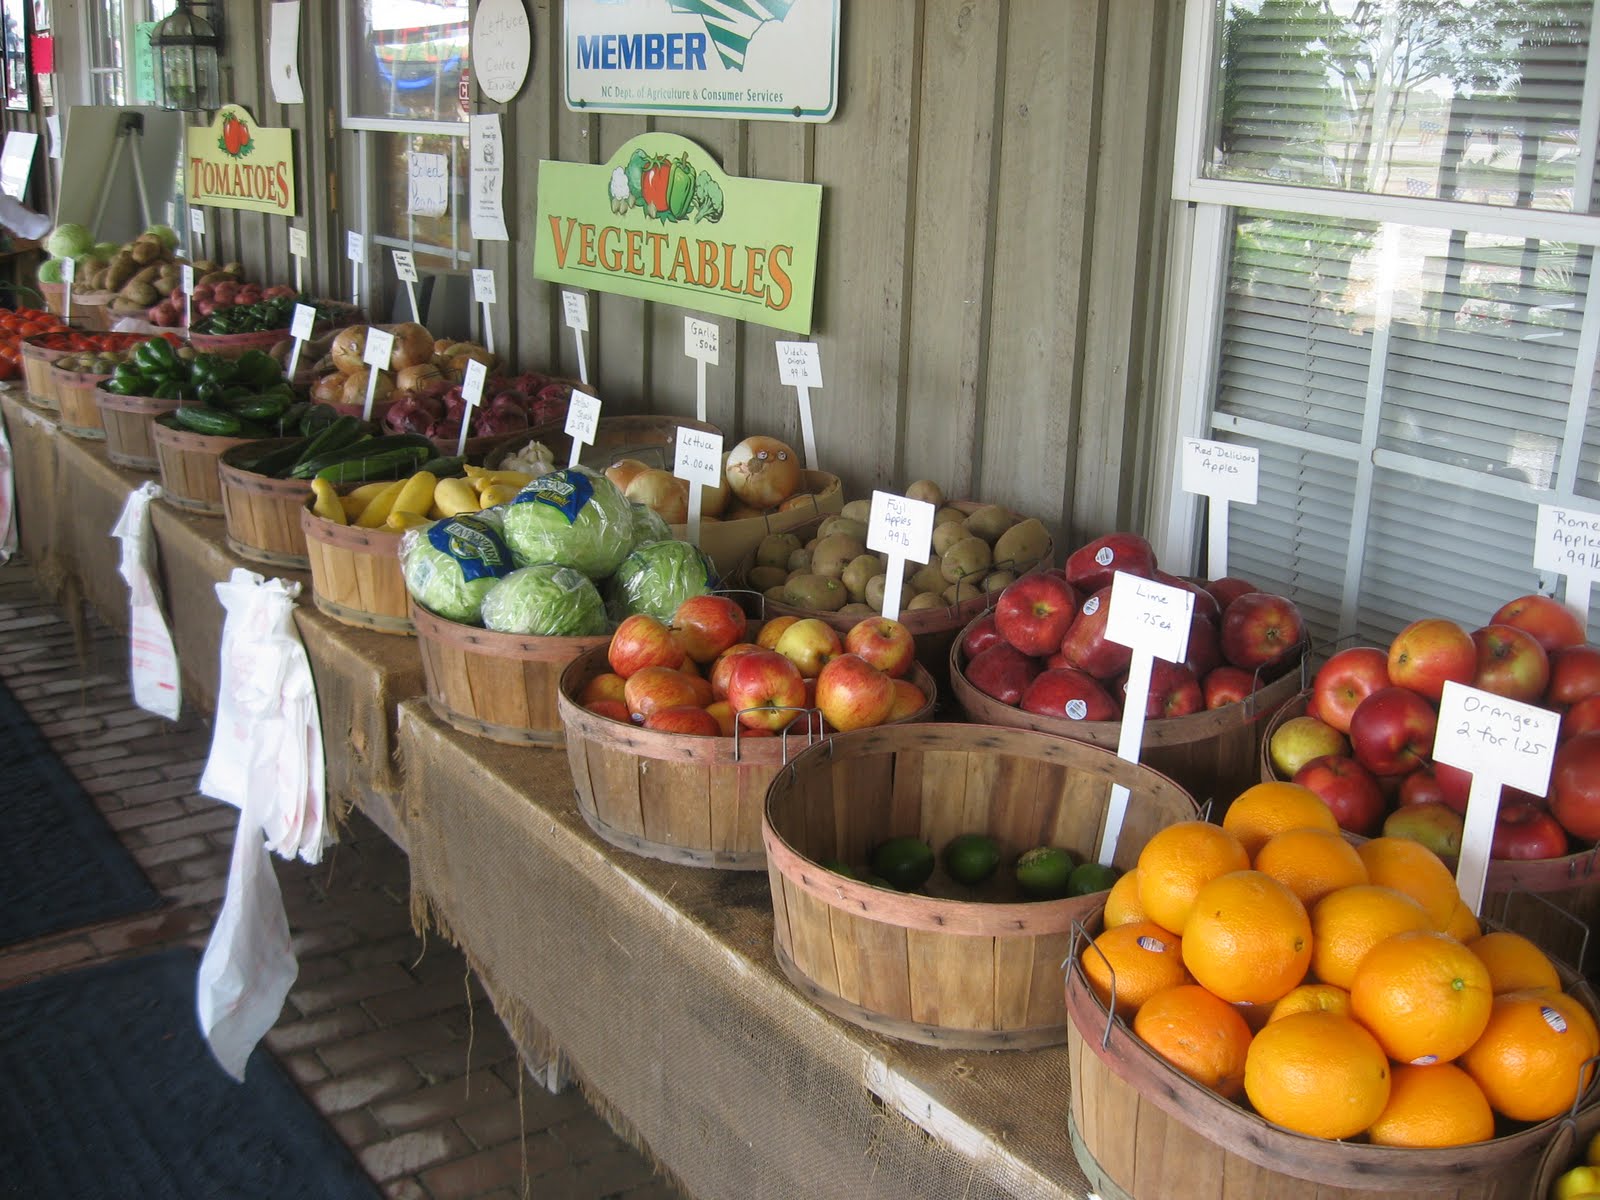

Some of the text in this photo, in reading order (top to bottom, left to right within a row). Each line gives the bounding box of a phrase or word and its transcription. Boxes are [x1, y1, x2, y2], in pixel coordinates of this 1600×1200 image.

[576, 32, 707, 71] MEMBER
[601, 86, 784, 103] NC Dept. of Agriculture & Consumer Services
[191, 157, 289, 209] TOMATOES
[548, 214, 794, 312] VEGETABLES
[682, 433, 714, 450] Lettuce
[1188, 441, 1256, 463] Red Delicious
[1202, 458, 1239, 474] Apples
[887, 498, 906, 515] Fuji
[885, 512, 912, 528] Apples
[1552, 510, 1600, 532] Rome
[1136, 583, 1169, 605] Lime
[1456, 721, 1471, 738] 2
[1476, 726, 1508, 747] for
